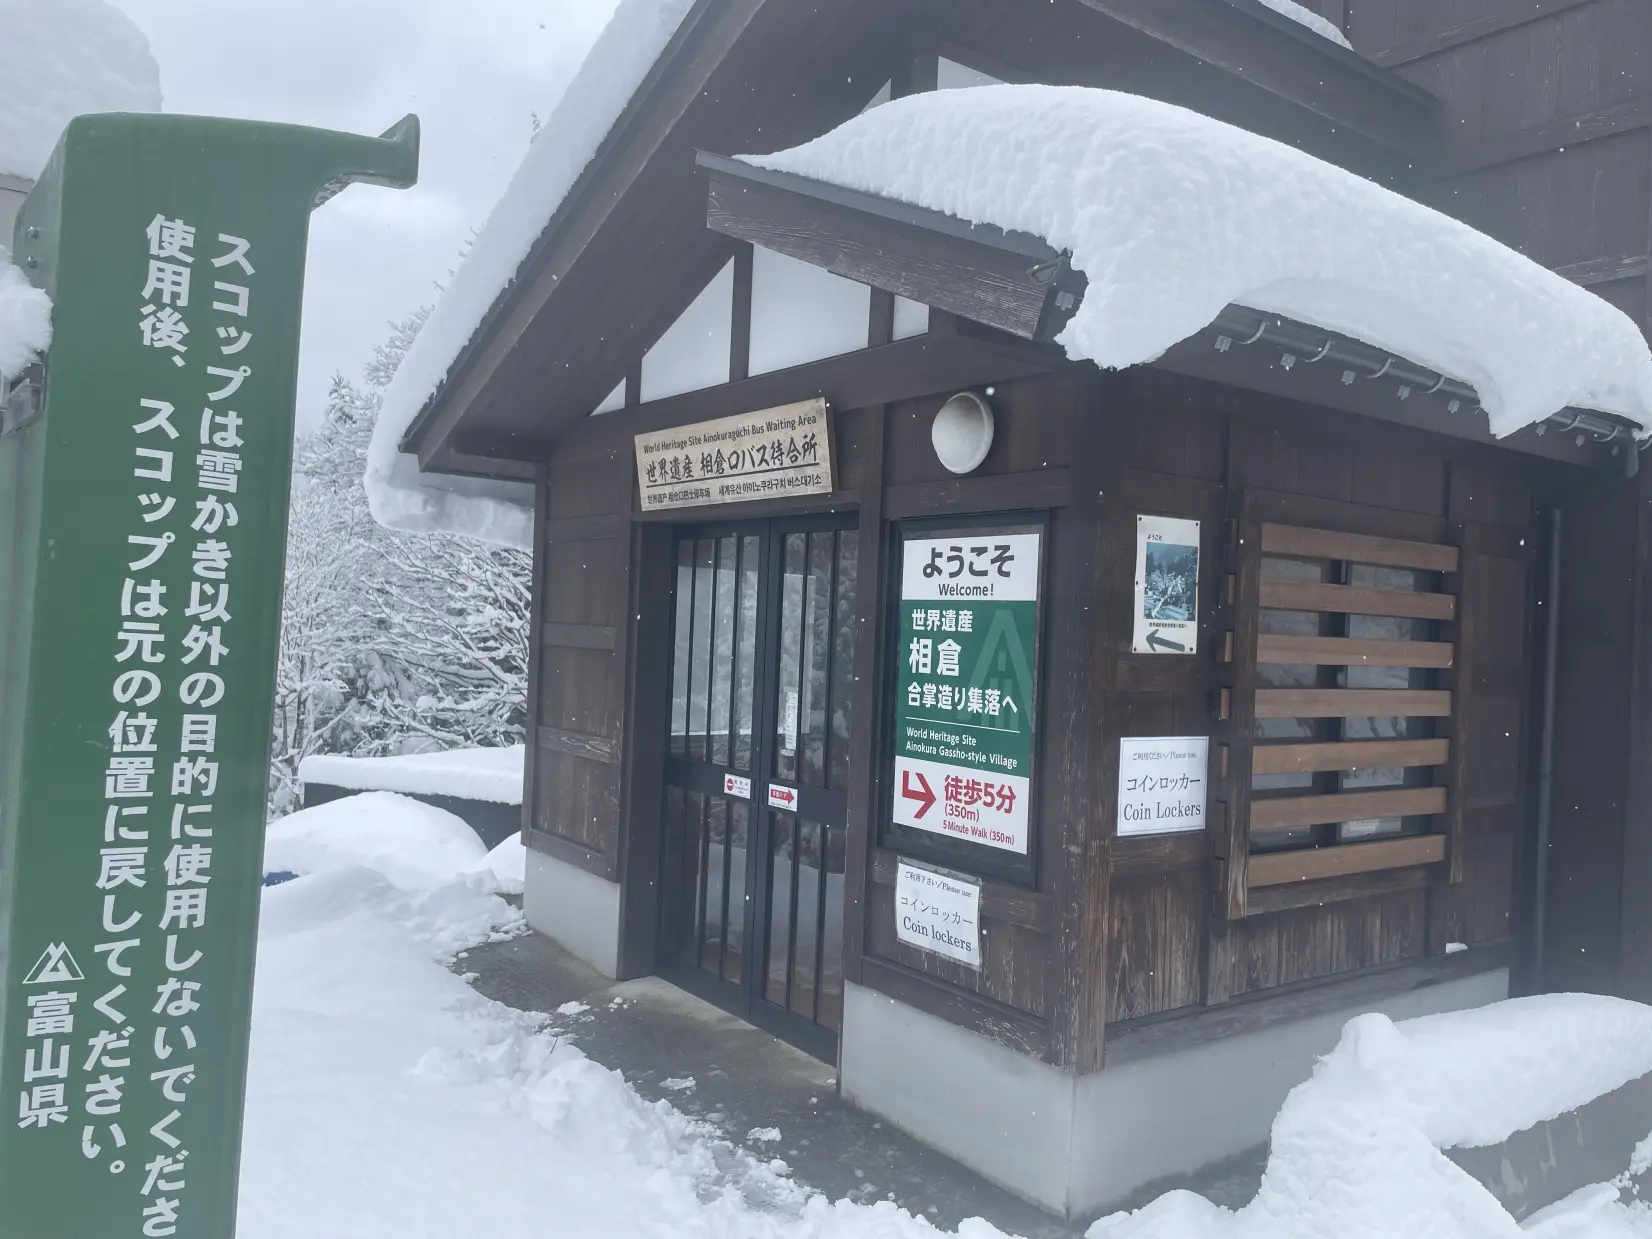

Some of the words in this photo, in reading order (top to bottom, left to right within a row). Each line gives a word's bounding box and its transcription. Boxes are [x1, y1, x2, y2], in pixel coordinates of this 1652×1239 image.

[643, 443, 660, 454] World
[661, 440, 688, 450] Heritage
[688, 436, 702, 446] Site
[703, 426, 750, 443] Ainokuraguchi
[751, 424, 765, 435] Bus
[766, 418, 796, 432] Waiting
[797, 415, 817, 426] Area
[646, 453, 695, 483] 世界遺産
[700, 432, 818, 476] 相倉口バス待合所
[922, 544, 1015, 579] ようこそ
[938, 583, 994, 596] Welcome!
[911, 608, 974, 632] 世界遺産
[908, 637, 962, 676] 相倉
[907, 681, 1018, 716] 合掌造り集落へ
[906, 726, 928, 739] World
[929, 729, 960, 745] Heritage
[961, 734, 977, 746] Site
[905, 740, 937, 755] Ainokura
[939, 745, 987, 764] Gassho-style
[989, 753, 1018, 770] Village
[944, 774, 1017, 814] 徒歩5分
[1126, 772, 1201, 793] コインロッカー
[944, 802, 980, 823] (350m)
[1123, 802, 1151, 821] Coin
[1155, 800, 1201, 819] Lockers
[970, 826, 988, 839] Walk
[900, 896, 973, 925] コインロッカー
[903, 916, 929, 937] Coin
[930, 924, 972, 952] lockers
[17, 990, 78, 1129] 富山県
